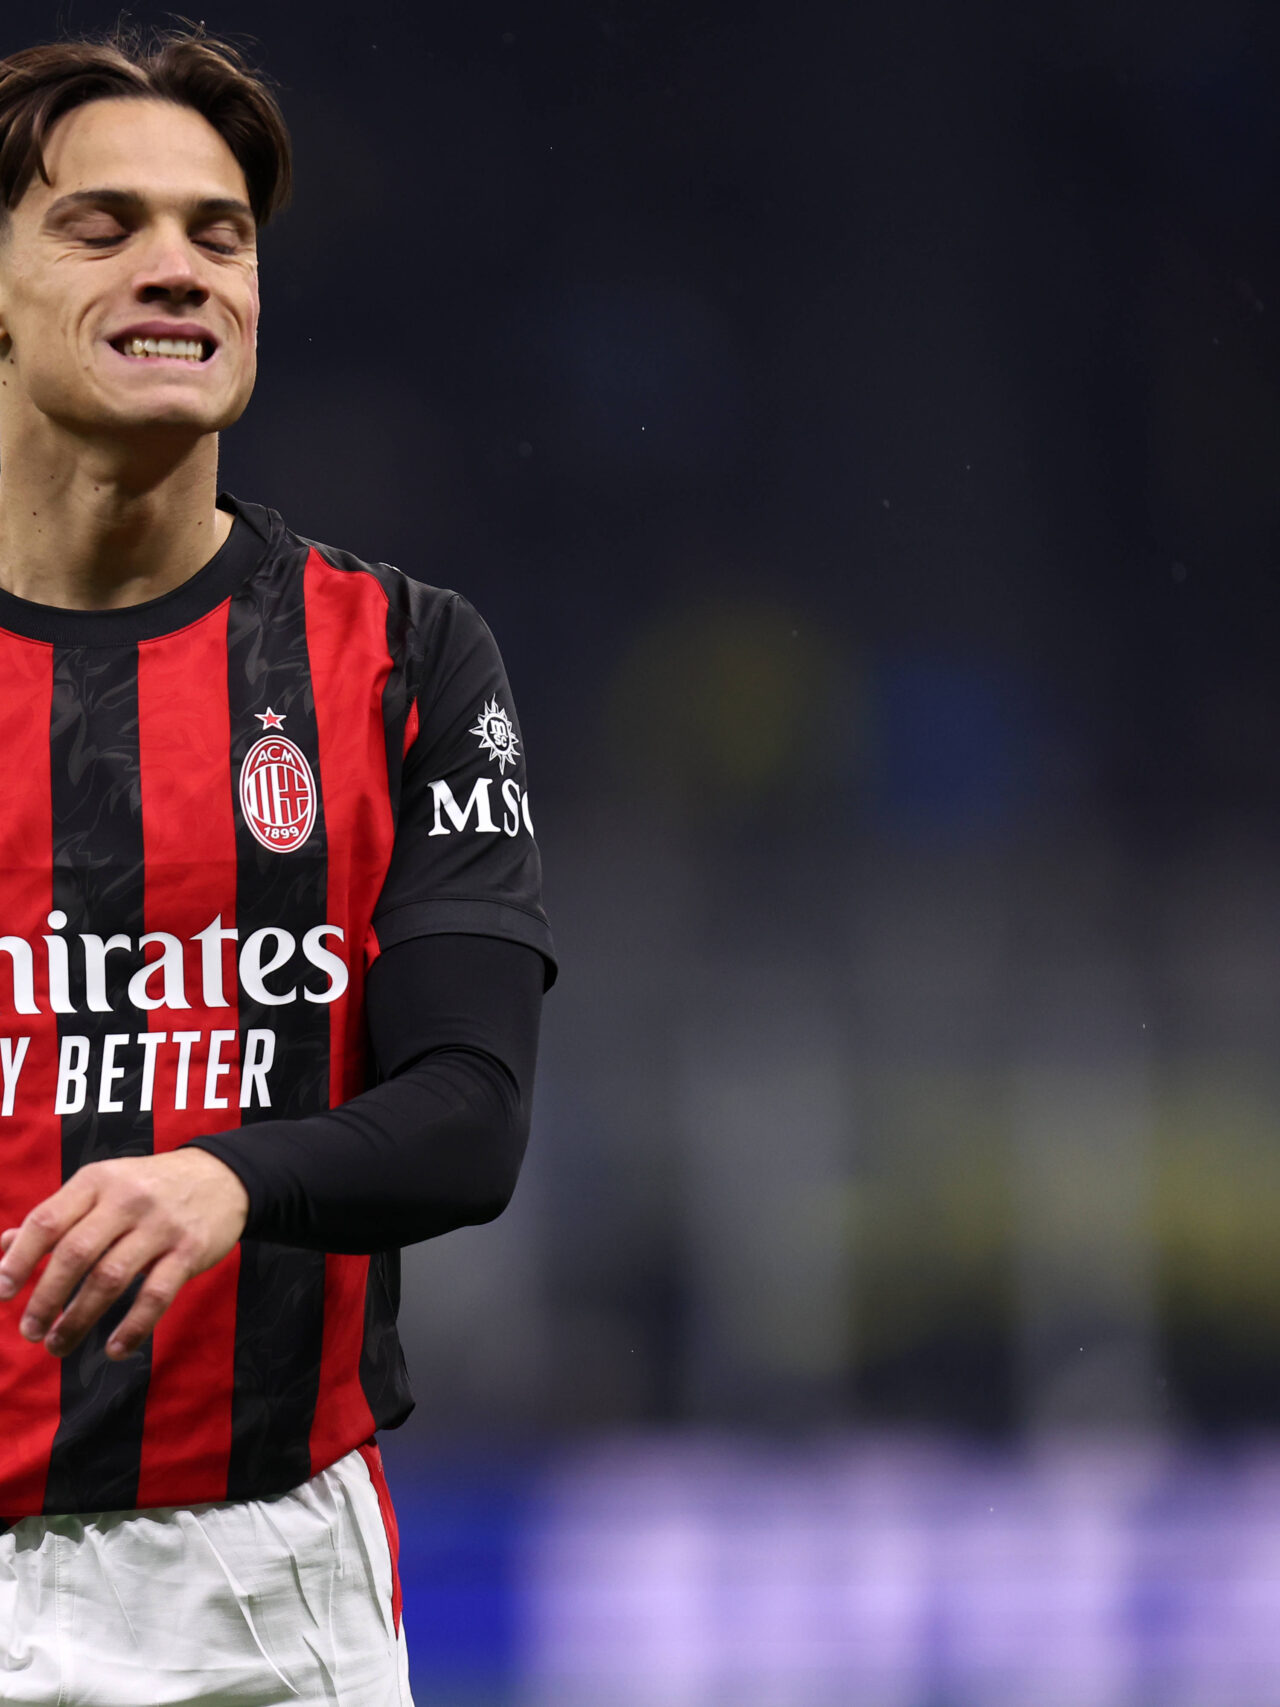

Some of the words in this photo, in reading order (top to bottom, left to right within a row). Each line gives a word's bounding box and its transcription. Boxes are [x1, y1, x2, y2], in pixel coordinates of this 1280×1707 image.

[254, 745, 296, 768] ACM
[263, 826, 300, 839] 1899
[54, 1028, 276, 1115] BETTER
